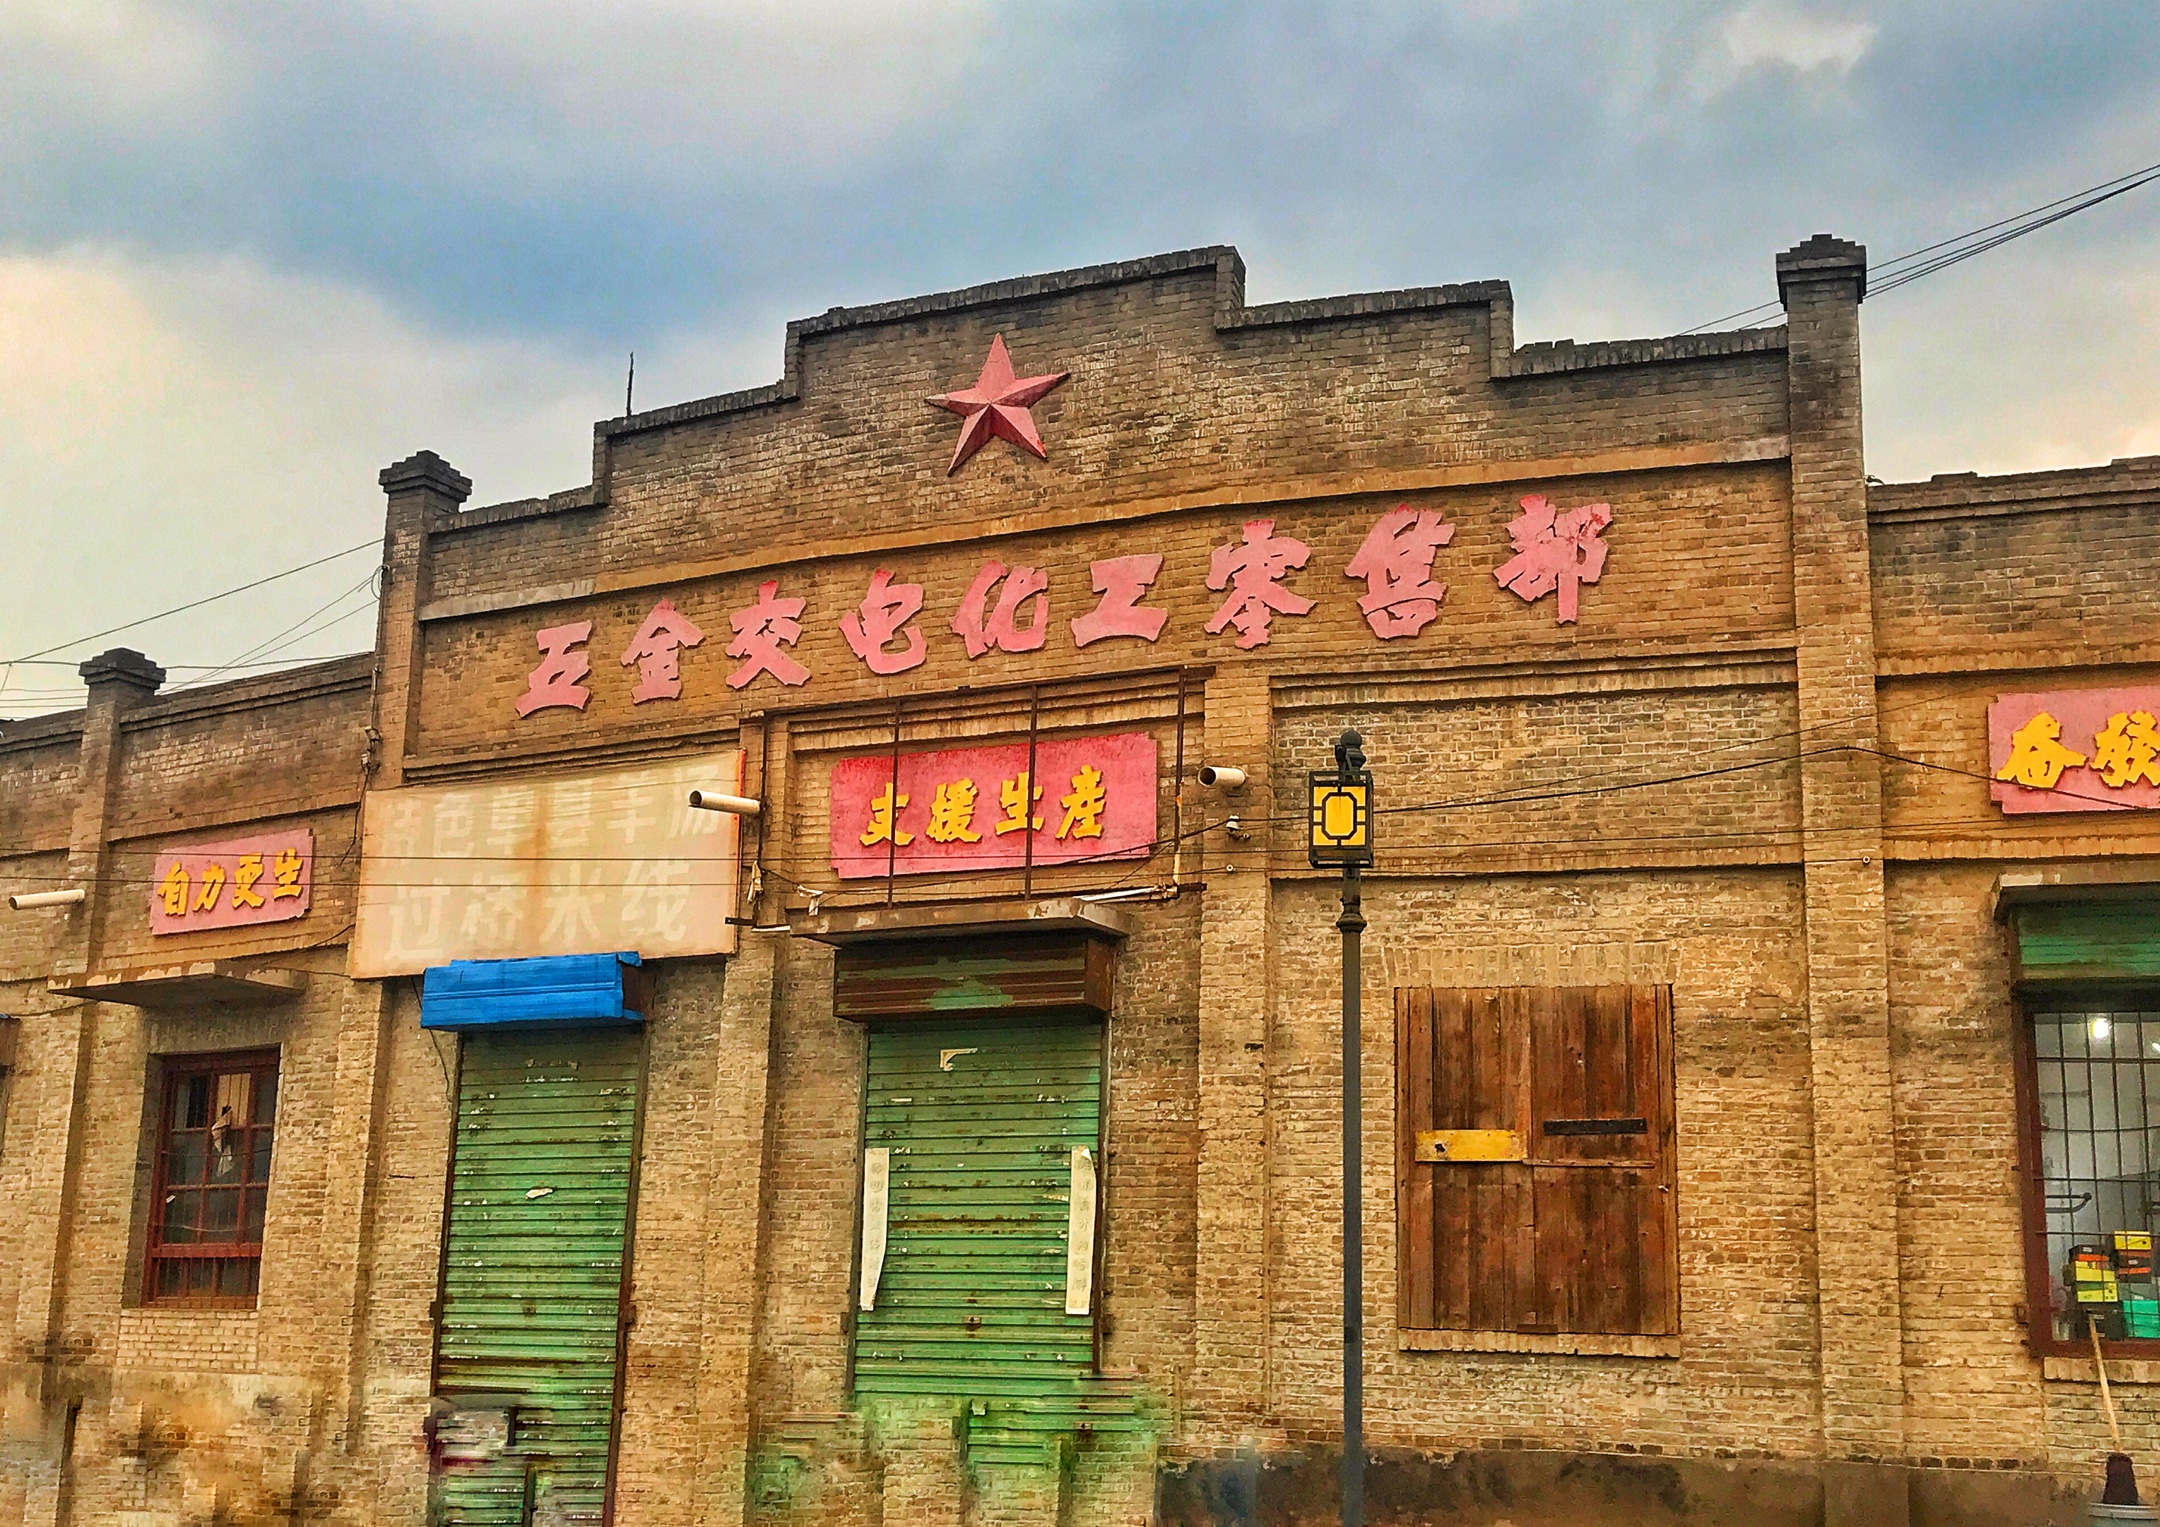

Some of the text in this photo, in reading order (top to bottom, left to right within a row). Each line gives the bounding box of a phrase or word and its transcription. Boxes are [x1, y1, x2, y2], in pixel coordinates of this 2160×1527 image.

[157, 847, 303, 917] 自力更生
[384, 856, 690, 960] 过桥米线
